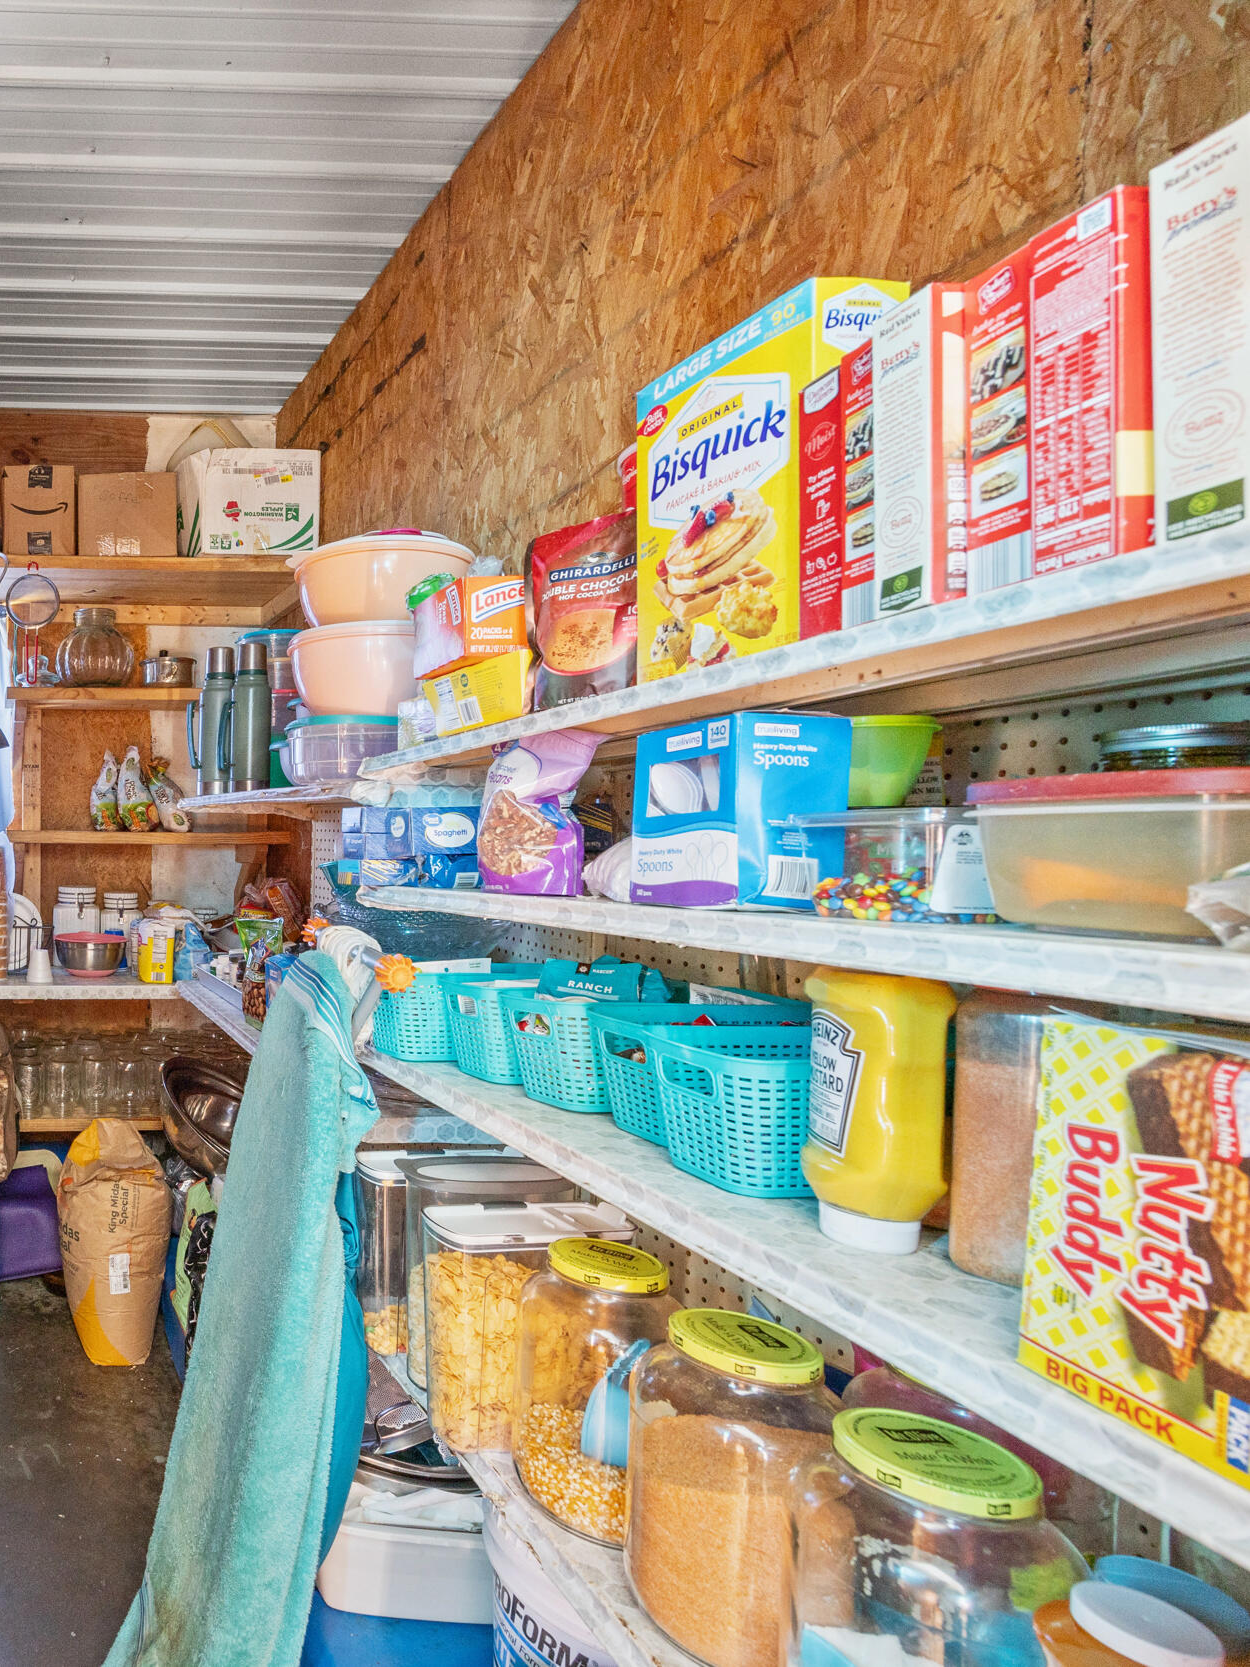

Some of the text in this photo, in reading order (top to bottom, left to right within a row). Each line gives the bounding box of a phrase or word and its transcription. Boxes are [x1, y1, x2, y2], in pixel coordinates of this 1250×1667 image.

[1167, 186, 1237, 231] Betty's
[772, 303, 796, 326] 90
[654, 316, 763, 400] LARGE SIZE
[681, 401, 739, 437] ORIGINAL
[651, 400, 786, 502] Bisquick
[805, 423, 837, 457] Moist
[666, 488, 700, 511] PANCAKE
[707, 471, 740, 492] BAKING
[742, 460, 762, 473] MIX
[550, 556, 636, 581] GHIRARDELLI
[475, 584, 526, 612] Lance
[542, 571, 637, 603] DOUBLE CHOCOLA
[558, 586, 620, 601] HOT COCOA MIX
[449, 588, 460, 622] Lance
[471, 627, 483, 640] 20
[710, 724, 726, 737] 140
[753, 742, 818, 753] Heavy Duty White
[753, 750, 810, 770] Spoons
[434, 829, 468, 839] Spaghetti
[637, 858, 673, 877] Spoons
[567, 980, 613, 994] RANCH
[1212, 1063, 1239, 1104] Little
[1214, 1103, 1237, 1159] Debbie
[109, 1178, 121, 1234] King Midas
[119, 1186, 129, 1225] Special
[1051, 1124, 1124, 1297] Buddy
[61, 1222, 80, 1241] das
[1120, 1156, 1212, 1347] Nutty
[1046, 1357, 1175, 1445] BIG PACK
[494, 1569, 590, 1667] ROFORM
